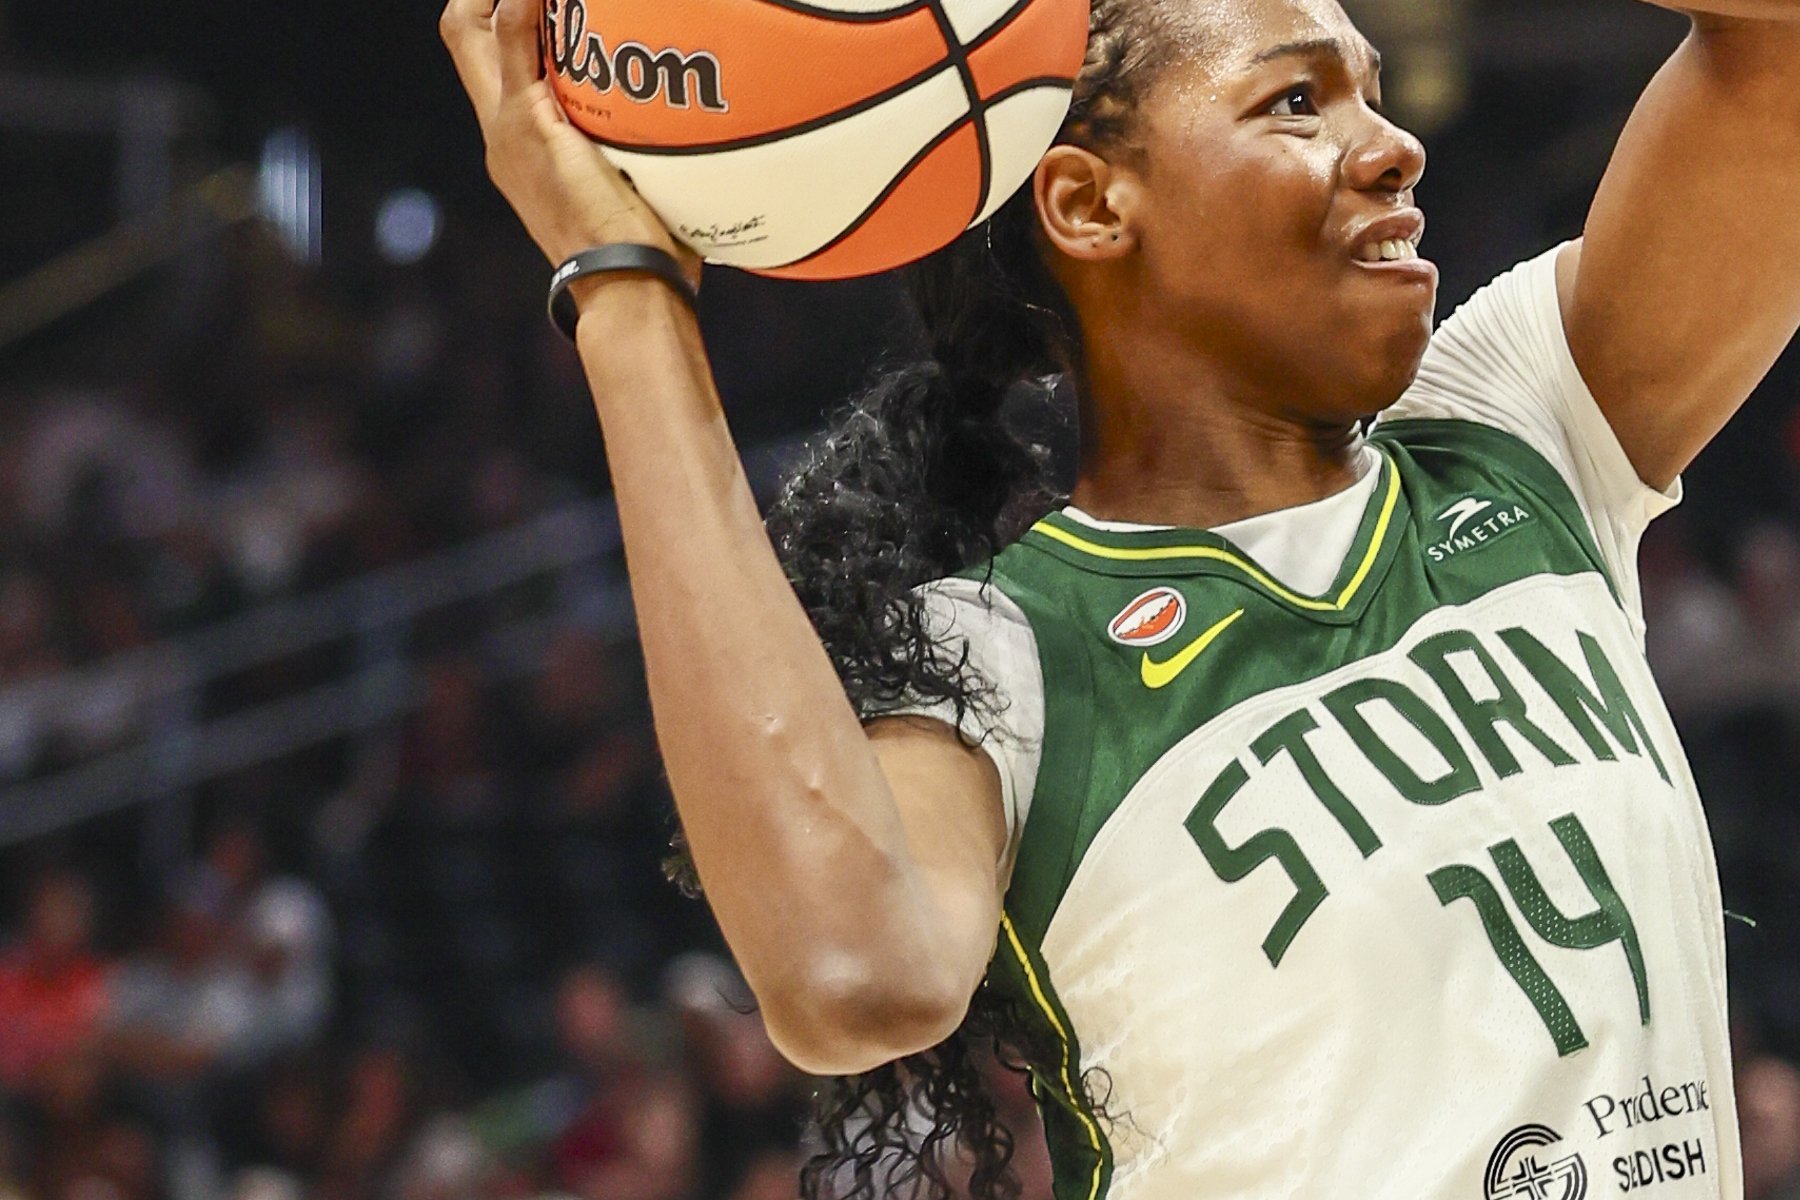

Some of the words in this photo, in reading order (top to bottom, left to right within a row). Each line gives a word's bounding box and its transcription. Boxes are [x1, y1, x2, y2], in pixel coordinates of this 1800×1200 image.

[1427, 504, 1530, 562] SYMETRA
[1183, 625, 1676, 969] STORM
[1425, 812, 1651, 1057] 14
